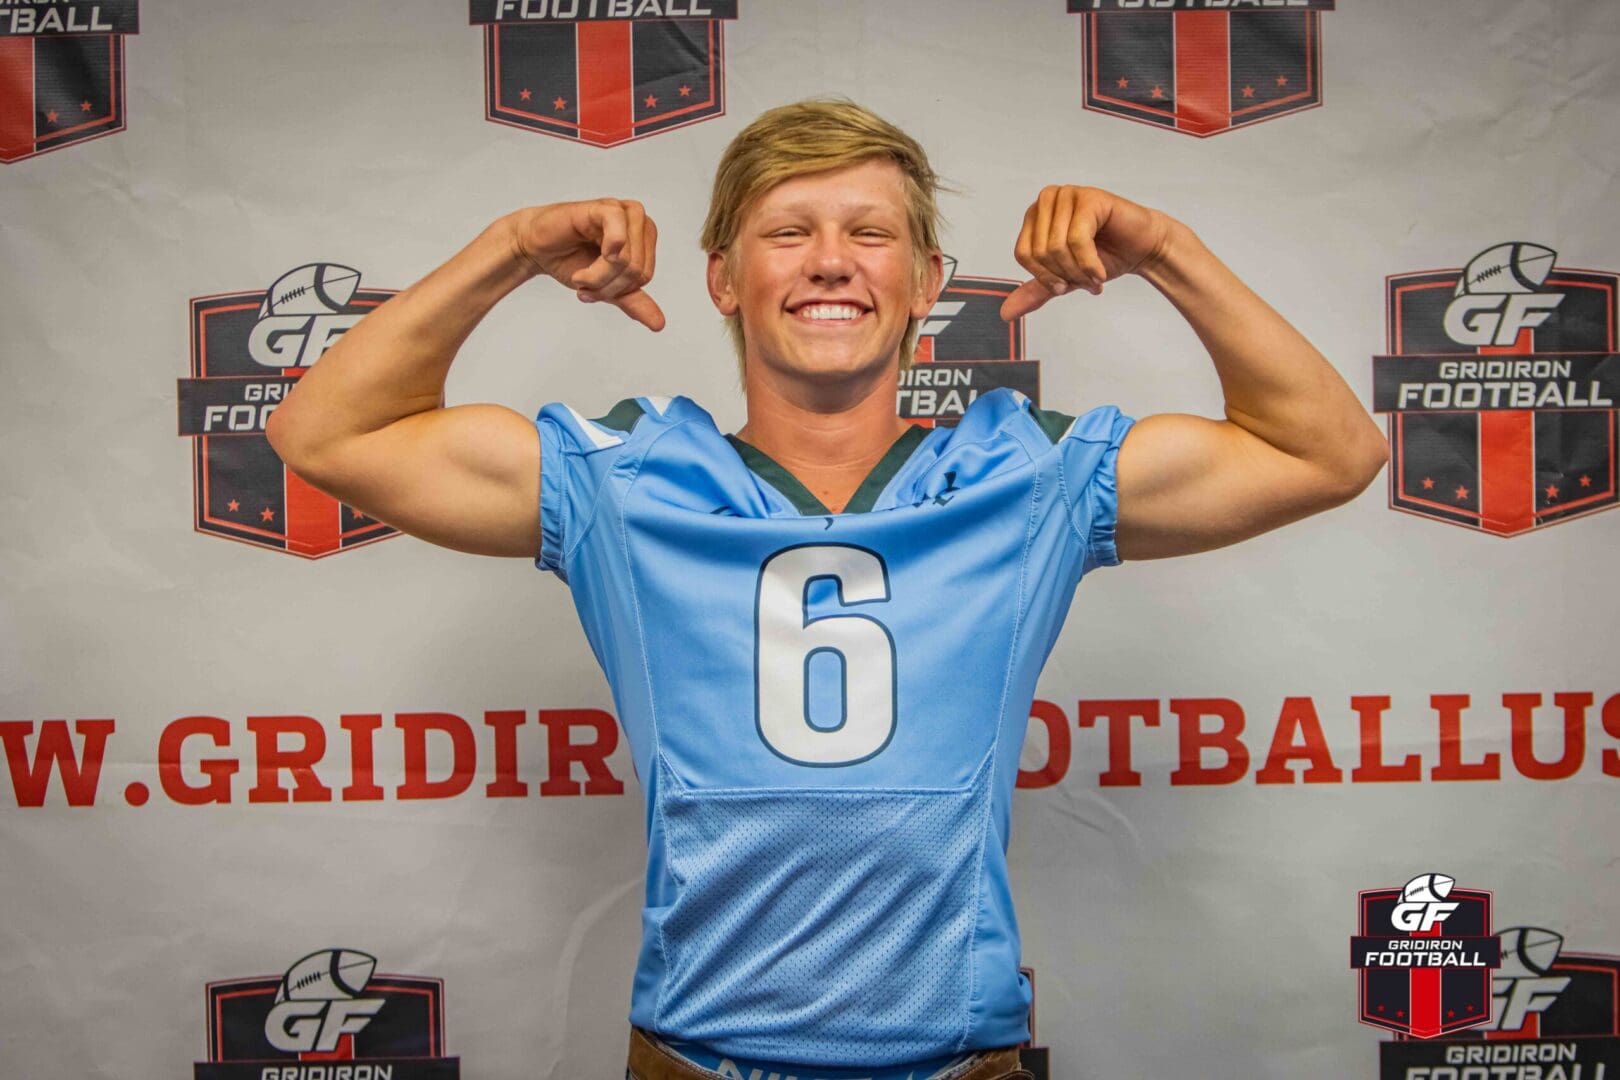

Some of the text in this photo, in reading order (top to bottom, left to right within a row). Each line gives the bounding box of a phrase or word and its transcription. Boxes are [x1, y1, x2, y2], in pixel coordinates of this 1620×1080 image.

[1443, 292, 1566, 346] GF
[1439, 360, 1571, 379] GRIDIRON
[1398, 381, 1613, 409] FOOTBALL
[754, 541, 897, 768] 6
[264, 998, 386, 1053] GF
[1445, 1043, 1576, 1064] GRIDIRON
[260, 1065, 393, 1080] GRIDIRON
